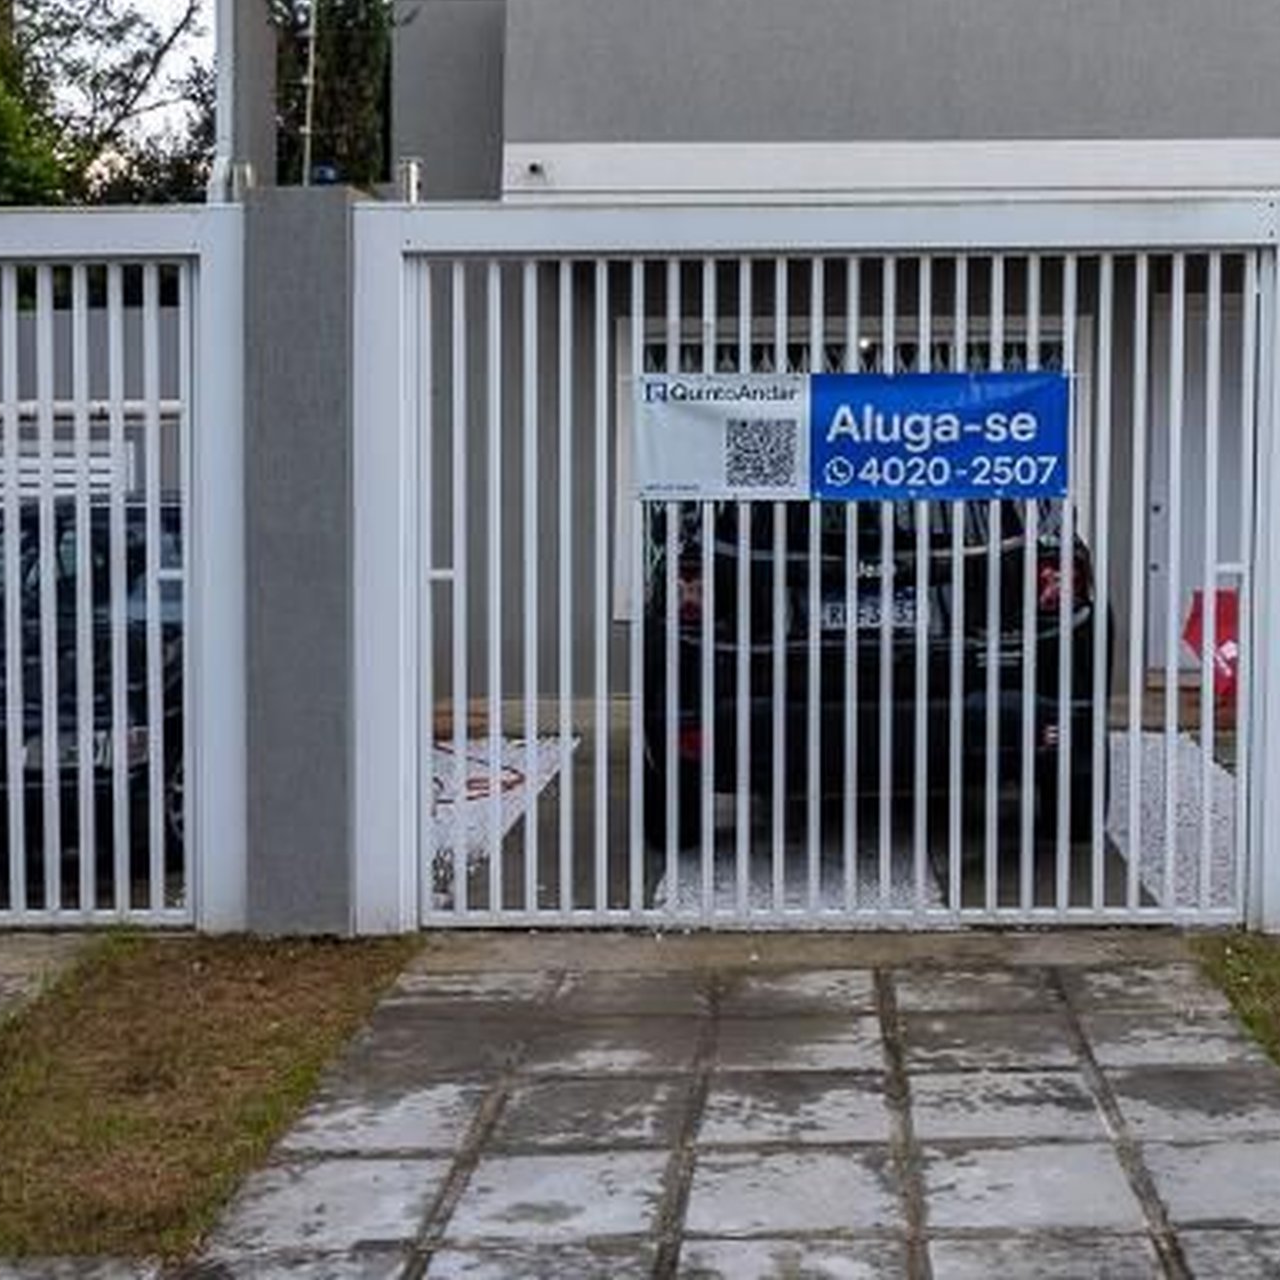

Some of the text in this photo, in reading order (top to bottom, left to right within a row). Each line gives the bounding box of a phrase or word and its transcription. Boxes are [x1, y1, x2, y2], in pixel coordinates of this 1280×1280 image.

[670, 383, 798, 401] QuintoAndar
[826, 404, 1037, 451] Aluga-se
[858, 456, 1058, 486] 4020-2507
